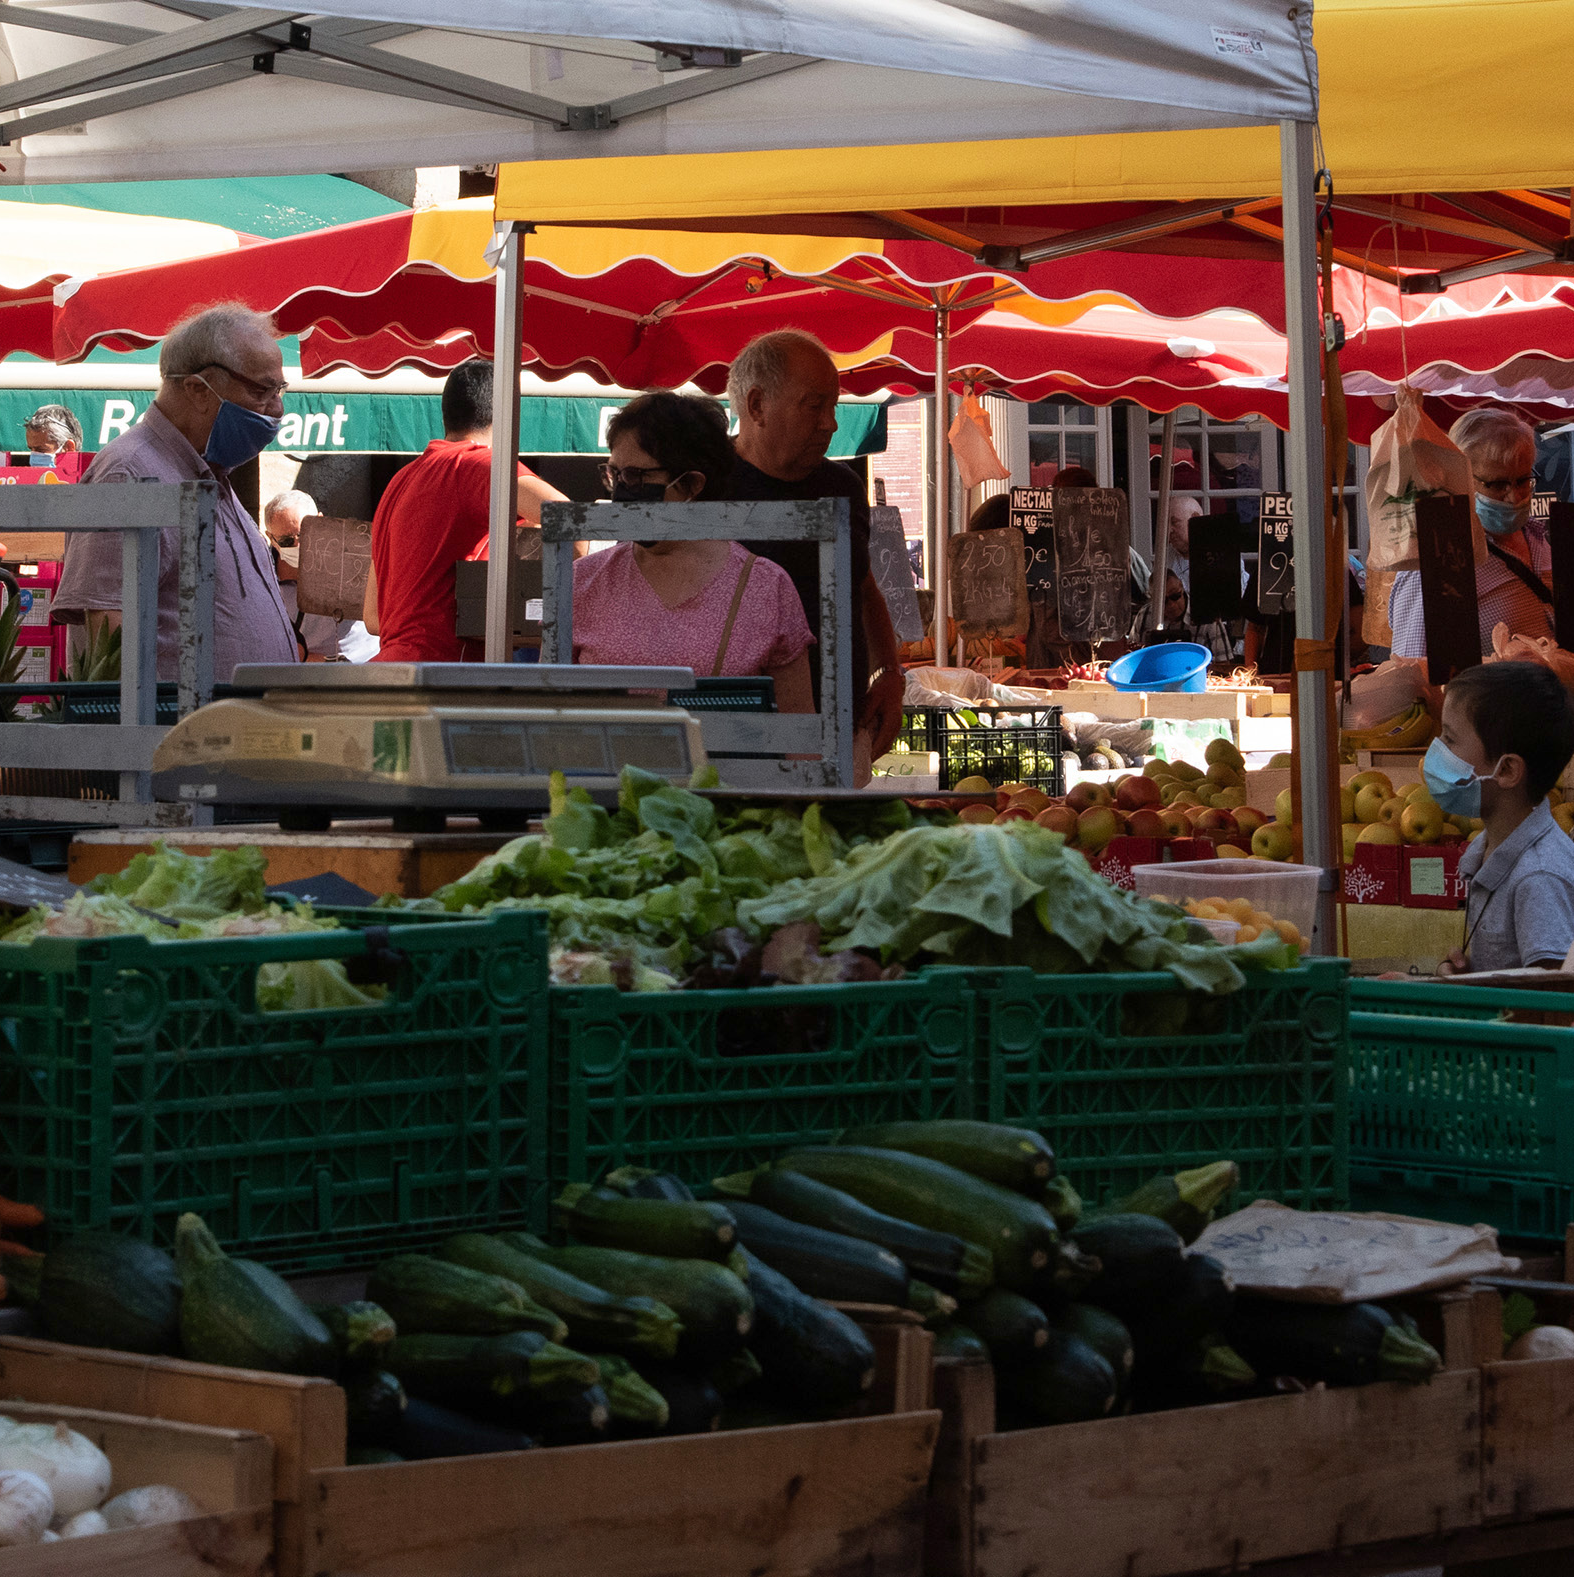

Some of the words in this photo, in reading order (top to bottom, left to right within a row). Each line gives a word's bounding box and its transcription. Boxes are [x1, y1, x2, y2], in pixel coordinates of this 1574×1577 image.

[1013, 514, 1022, 527] le
[1024, 515, 1037, 527] KG
[1264, 521, 1273, 535] le
[1275, 522, 1289, 535] KG
